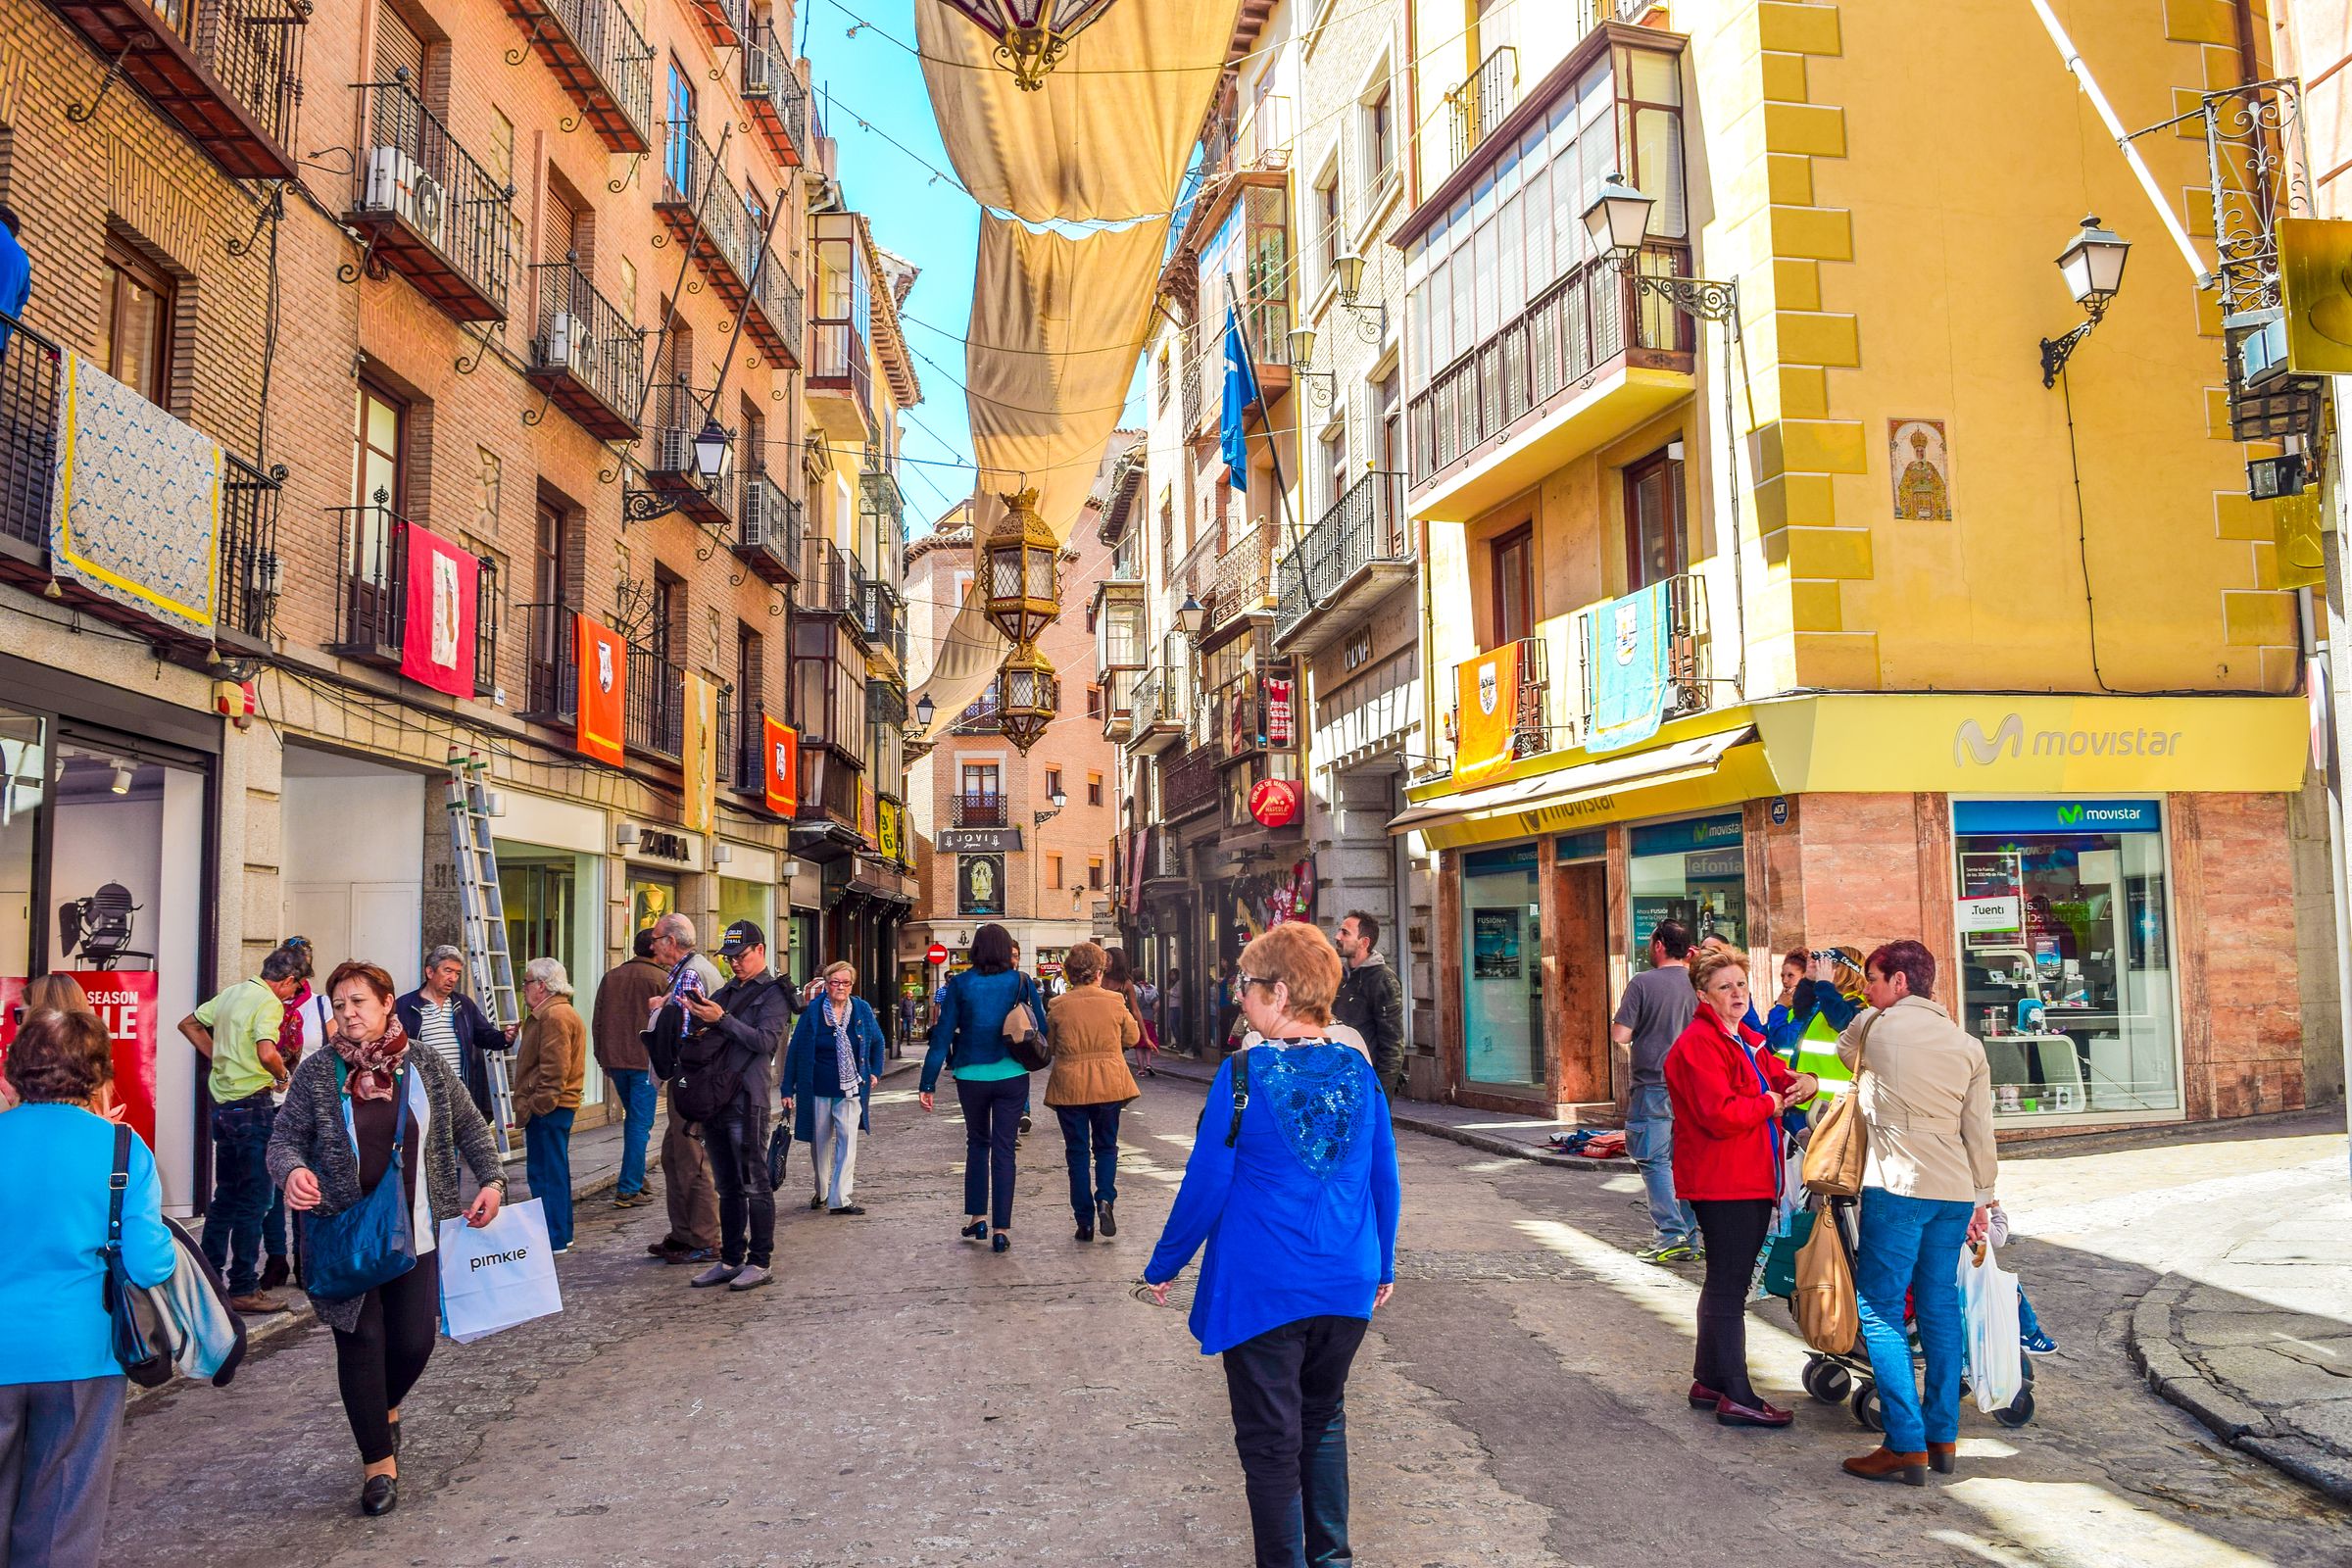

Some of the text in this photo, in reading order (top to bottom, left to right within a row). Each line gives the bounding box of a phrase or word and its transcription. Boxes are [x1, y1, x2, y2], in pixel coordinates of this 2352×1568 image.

[2033, 728, 2182, 757] movistar
[1774, 804, 1786, 814] ADT
[2086, 808, 2140, 820] movistar
[1709, 823, 1742, 837] movistar
[639, 828, 691, 861] ZARA
[956, 834, 988, 843] JOVI
[1686, 855, 1743, 874] lefonía
[87, 991, 138, 1004] SEASON
